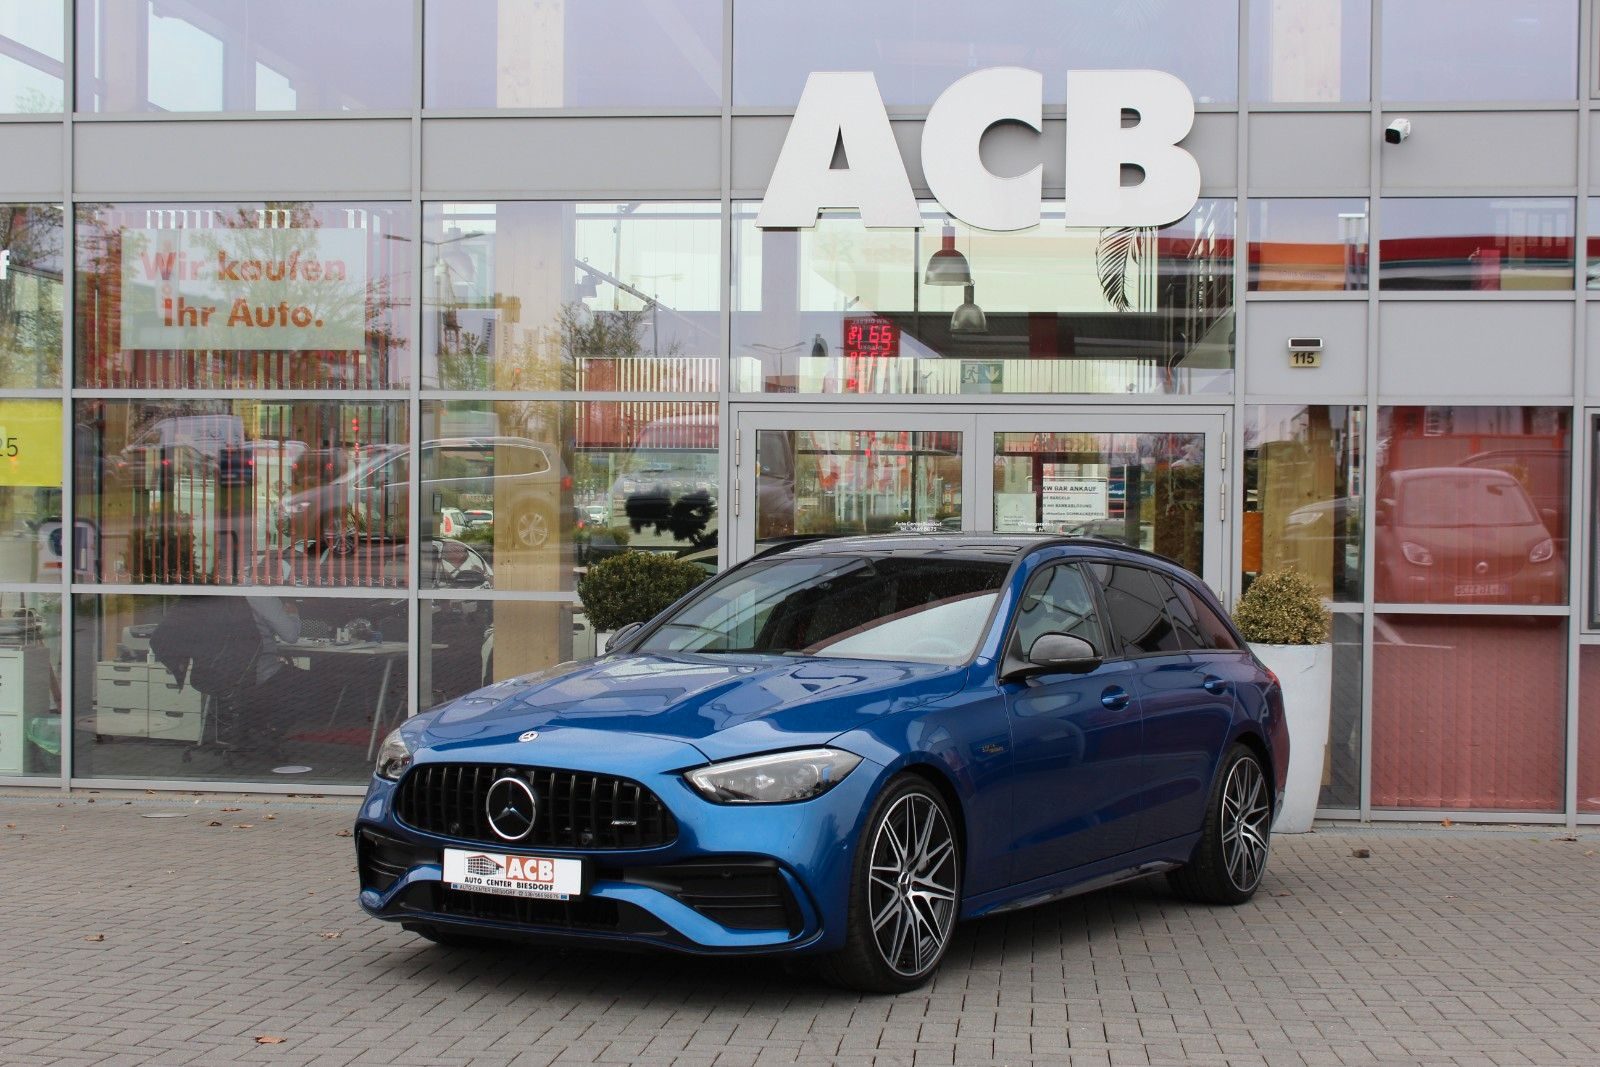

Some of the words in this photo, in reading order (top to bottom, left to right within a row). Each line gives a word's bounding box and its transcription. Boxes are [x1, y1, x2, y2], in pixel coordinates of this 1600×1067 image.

[754, 66, 1201, 231] ACB
[141, 251, 205, 281] Wir
[218, 249, 346, 282] kaufen
[164, 297, 216, 327] Ihr
[227, 297, 324, 328] Auto.
[1293, 352, 1315, 365] 115
[0, 437, 19, 457] 5
[507, 857, 554, 882] ACB
[464, 877, 482, 885] AUTO
[486, 879, 512, 888] CENTER
[516, 882, 554, 891] BIESDORF
